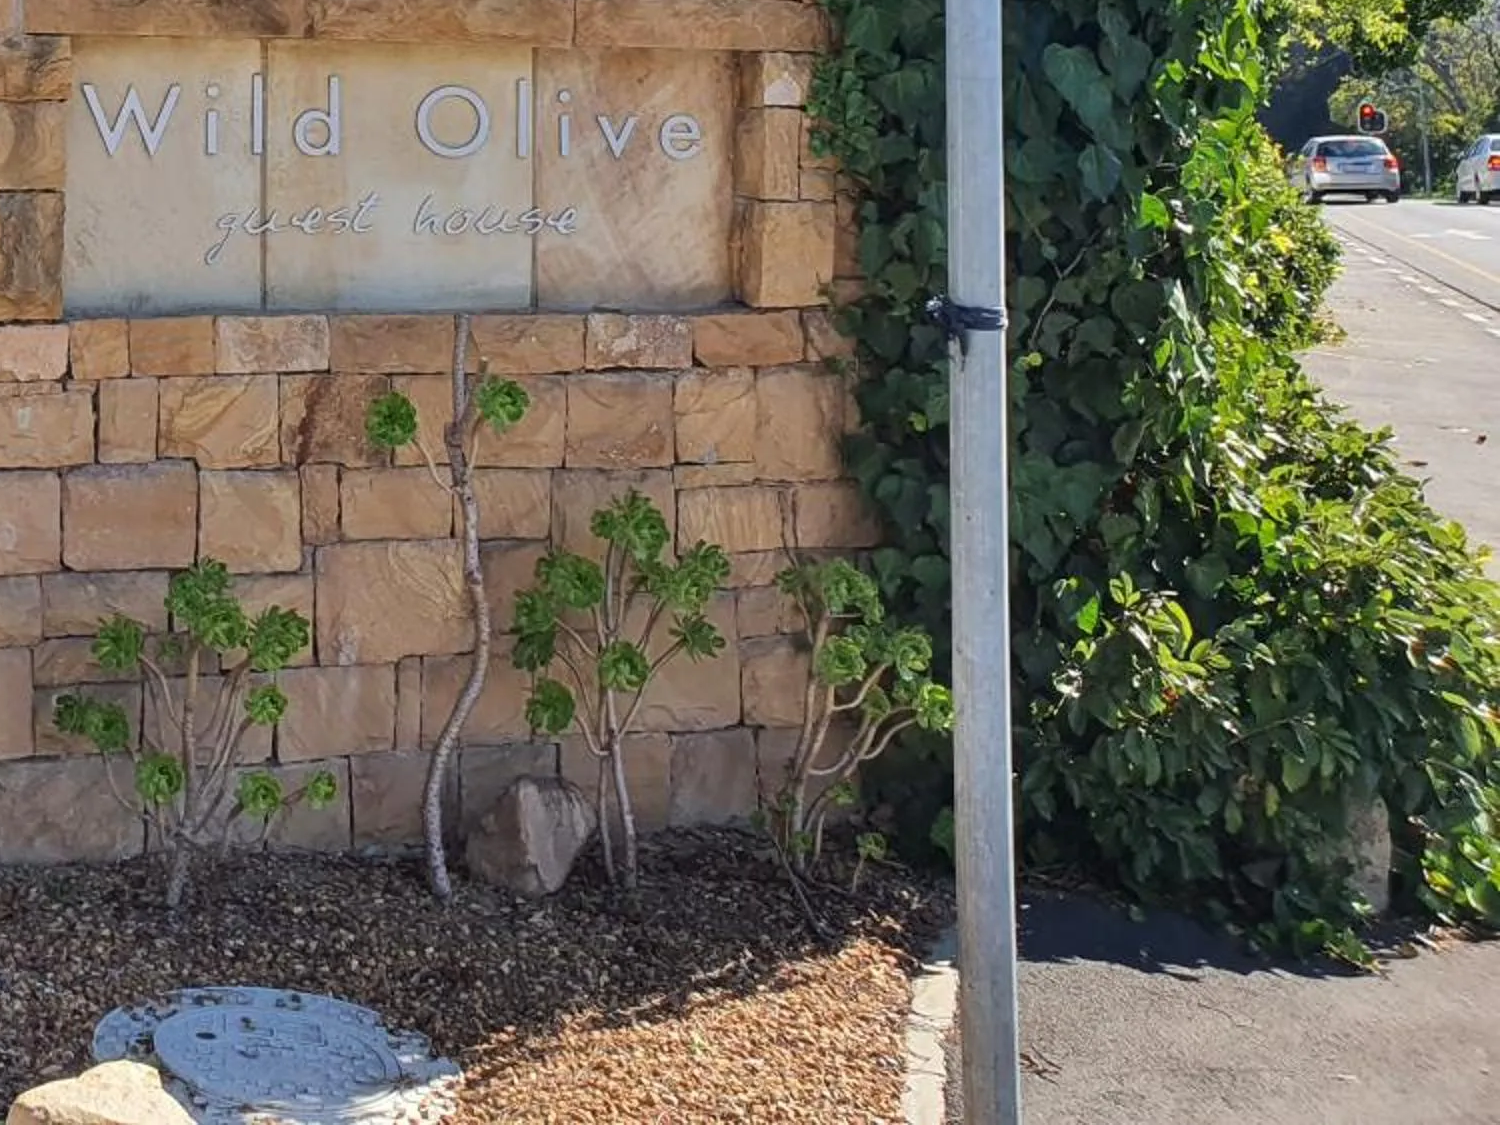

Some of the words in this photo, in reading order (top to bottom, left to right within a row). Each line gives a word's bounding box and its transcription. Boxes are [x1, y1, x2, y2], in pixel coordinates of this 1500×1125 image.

[82, 73, 340, 158] Wild
[415, 76, 702, 160] Olive
[203, 190, 381, 265] guest
[412, 192, 581, 237] house
